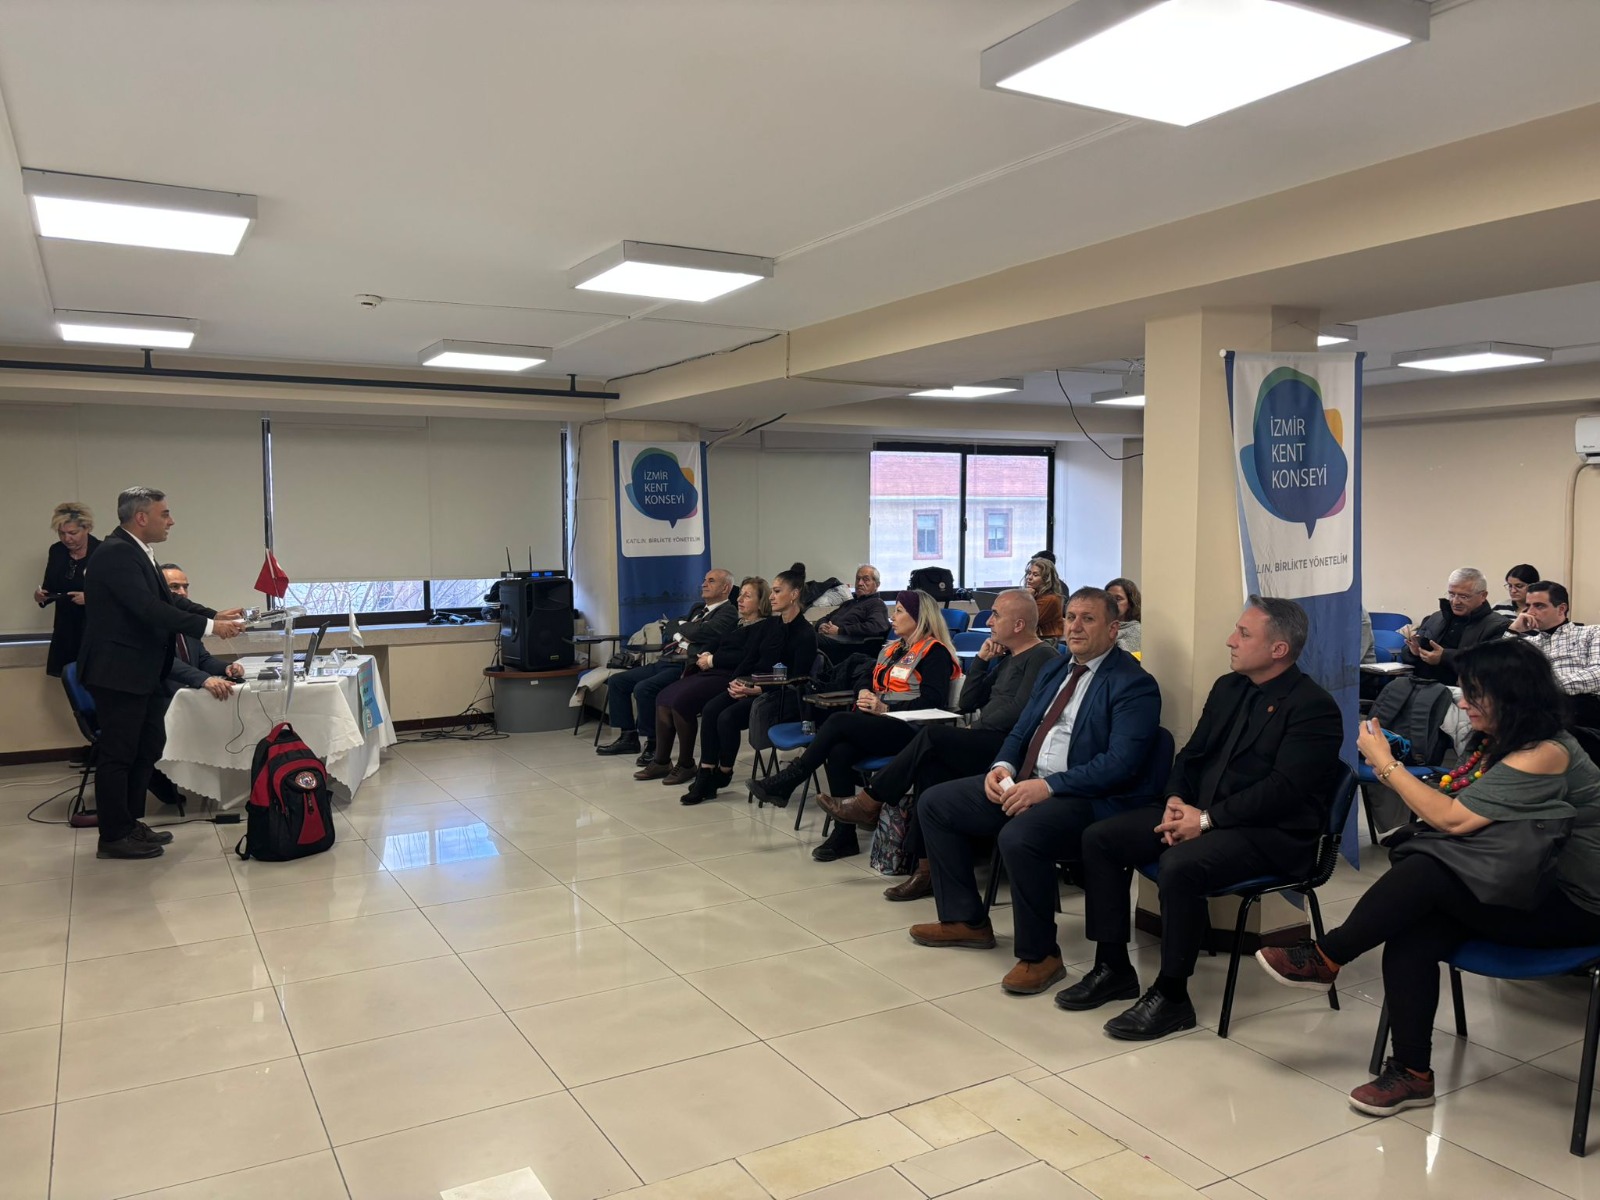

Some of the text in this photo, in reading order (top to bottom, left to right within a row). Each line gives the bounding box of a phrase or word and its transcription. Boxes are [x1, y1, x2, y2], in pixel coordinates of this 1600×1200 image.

[1270, 415, 1305, 437] İZMİR
[1271, 443, 1306, 463] KENT
[643, 470, 669, 480] İZMİR
[1271, 464, 1327, 489] KONSEYİ
[644, 483, 669, 493] KENT
[644, 493, 685, 505] KONSEYİ
[1274, 558, 1308, 573] BİRLİKTE
[1309, 552, 1348, 568] YÖNETELİM
